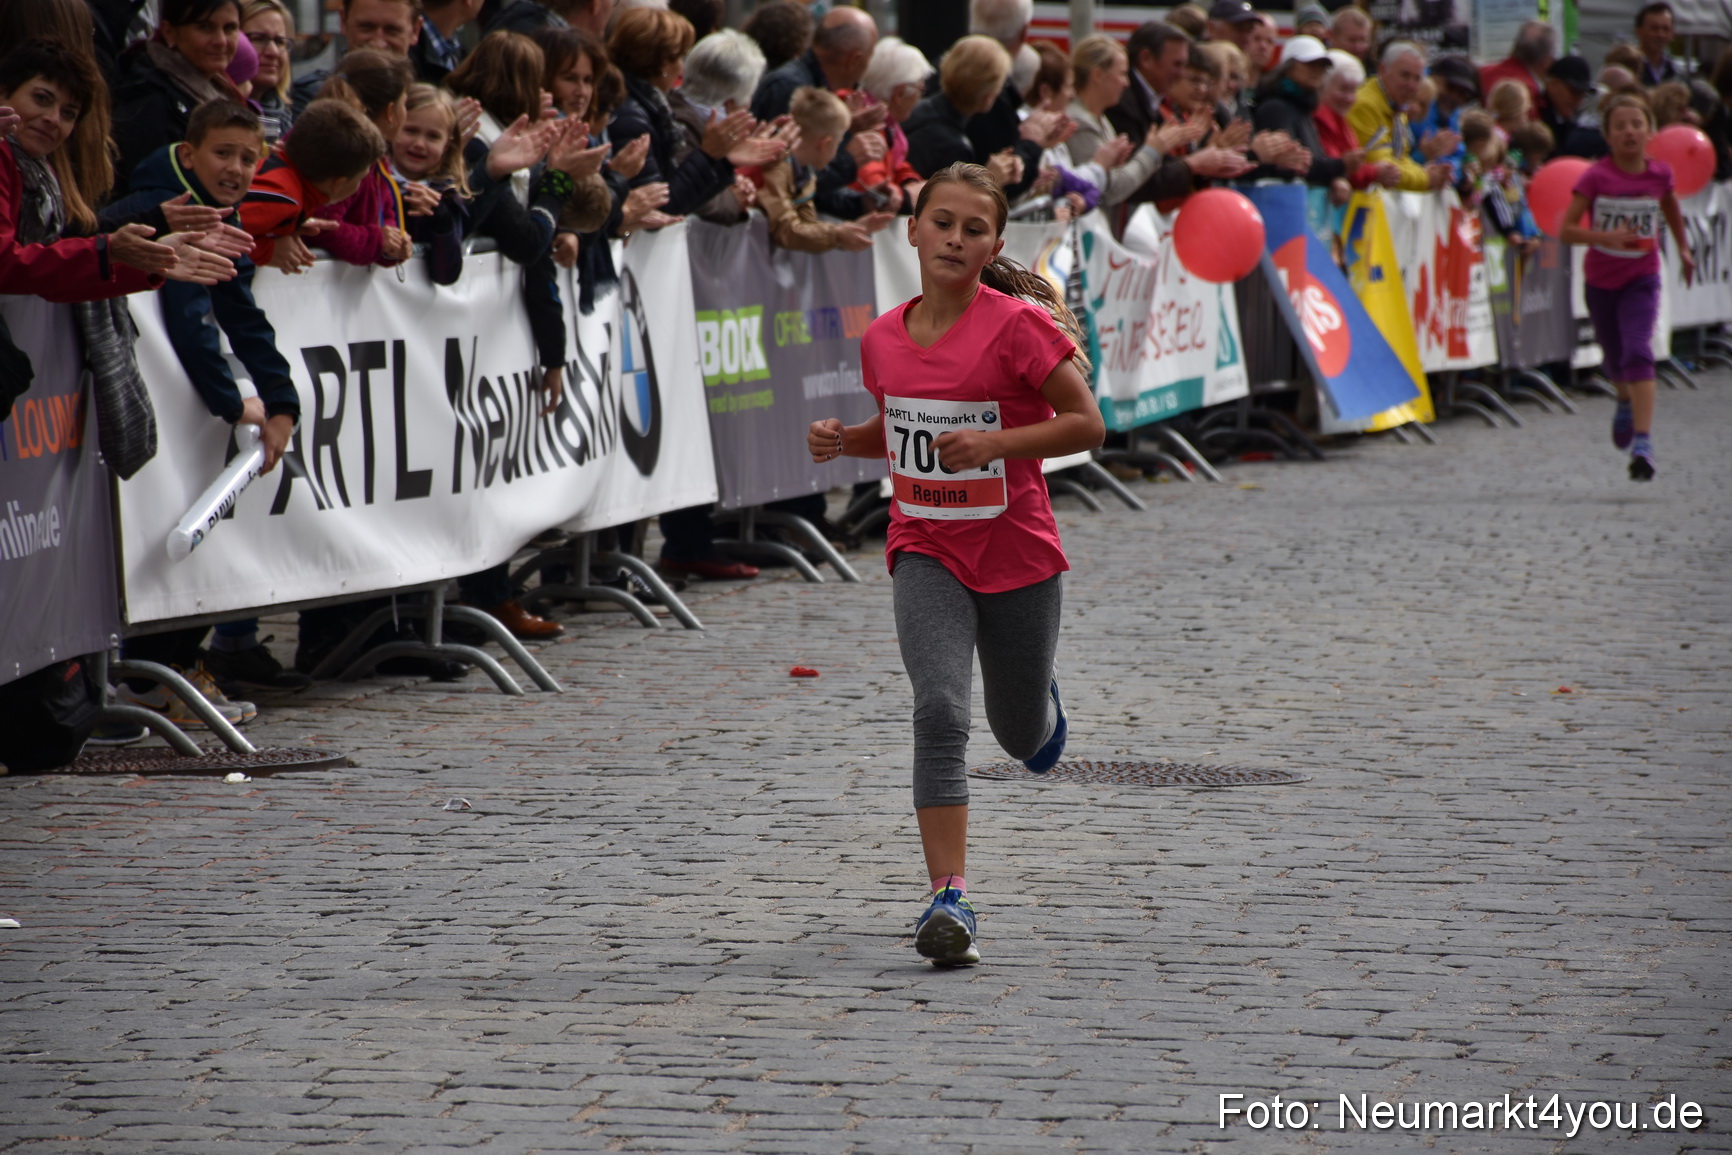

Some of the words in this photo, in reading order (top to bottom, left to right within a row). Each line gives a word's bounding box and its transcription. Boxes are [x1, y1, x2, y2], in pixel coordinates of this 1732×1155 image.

[885, 406, 915, 423] PARTL
[917, 411, 977, 425] Neumarkt
[894, 425, 991, 475] 70
[912, 483, 968, 507] Regina
